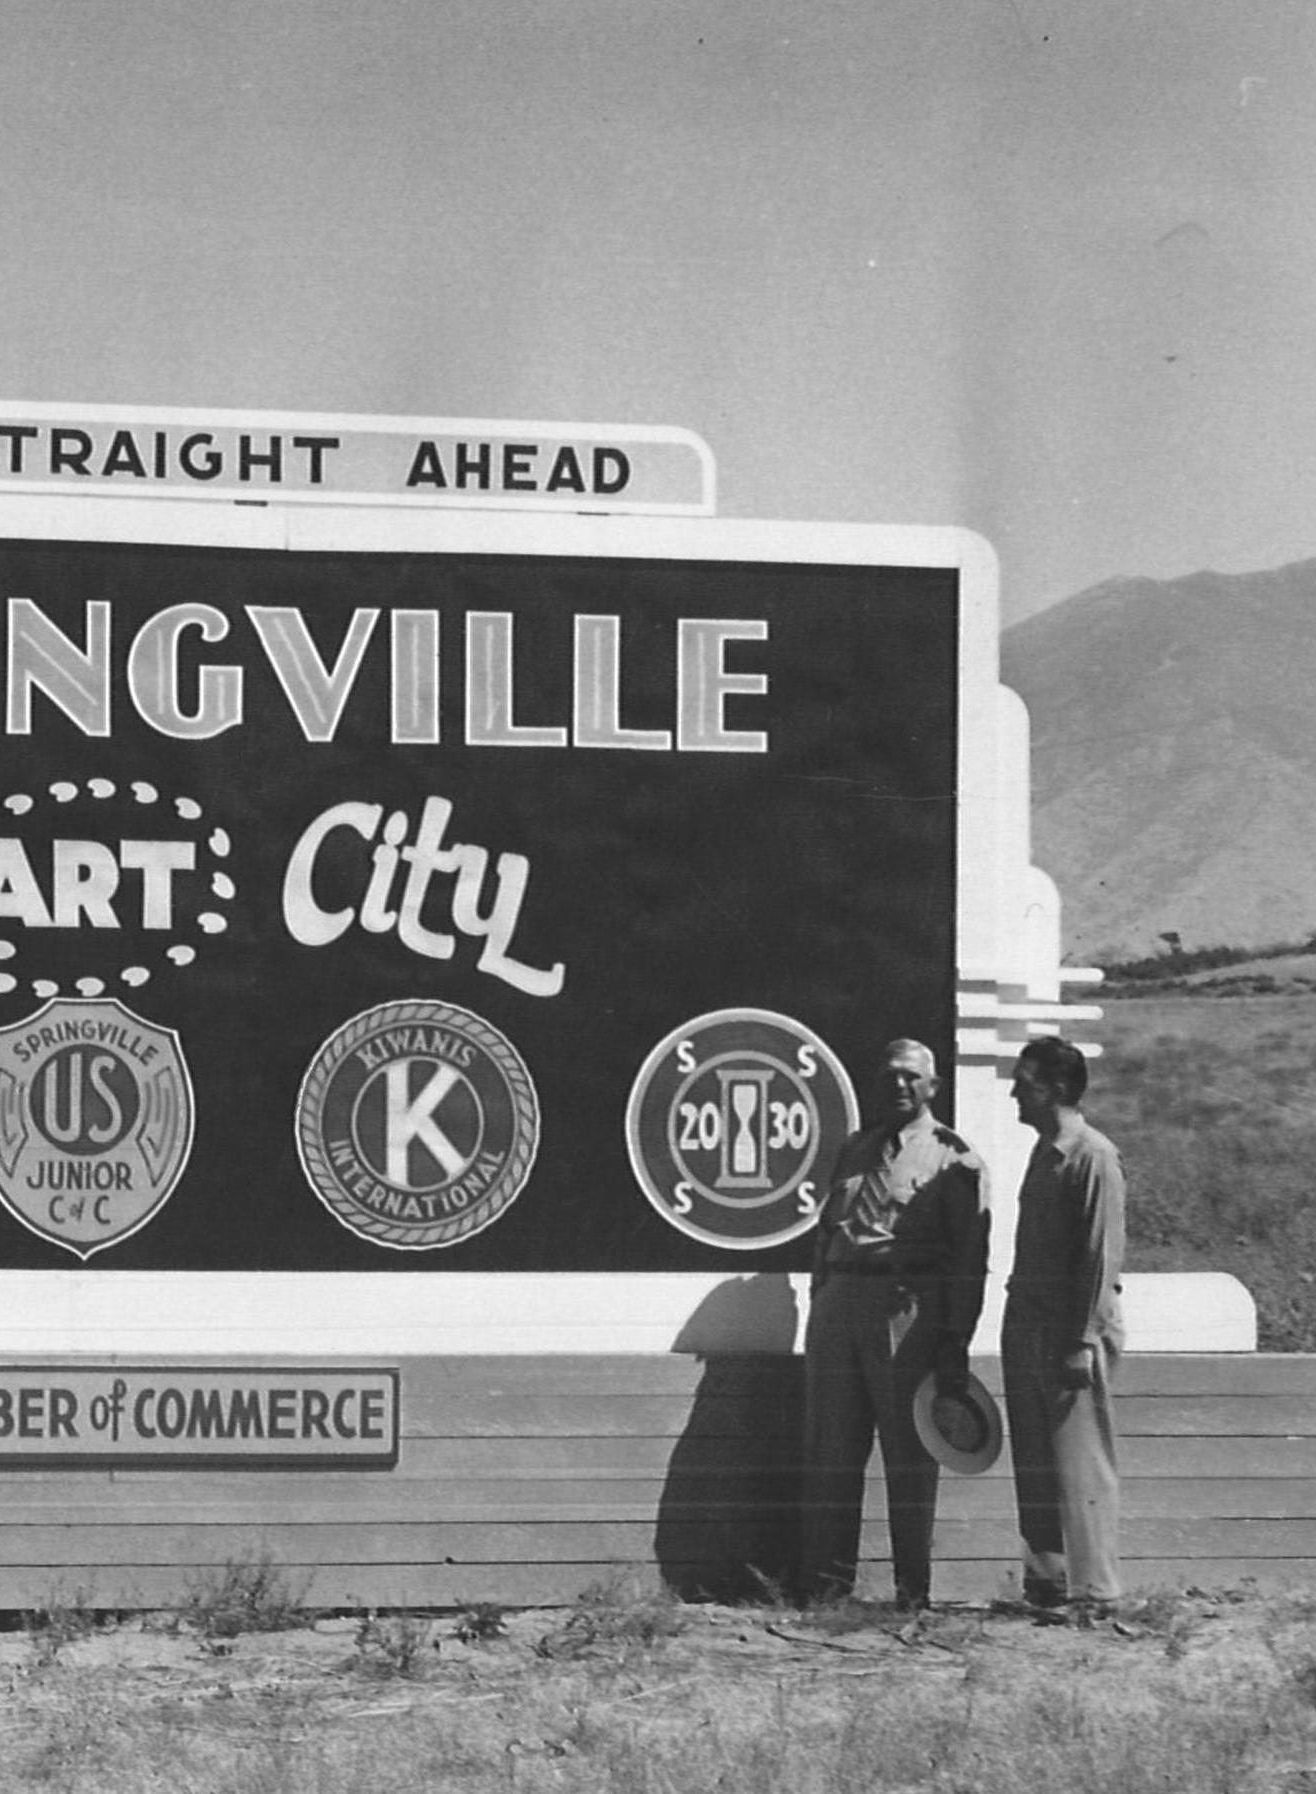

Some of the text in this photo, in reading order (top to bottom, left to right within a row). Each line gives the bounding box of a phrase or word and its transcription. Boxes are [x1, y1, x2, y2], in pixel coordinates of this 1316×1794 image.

[407, 441, 632, 494] AHEAD
[284, 796, 566, 997] City
[12, 1019, 160, 1067] SPRINGVILLE
[355, 1028, 477, 1071] KIWANIS
[677, 1040, 818, 1078] S S
[44, 1052, 122, 1143] US
[387, 1058, 469, 1188] K
[680, 1101, 809, 1150] 20 30
[26, 1160, 133, 1191] JUNIOR
[329, 1139, 505, 1218] INTERNATIONAL
[673, 1181, 816, 1214] S S
[48, 1195, 66, 1224] C
[93, 1195, 111, 1225] C
[89, 1378, 127, 1442] of
[132, 1387, 384, 1440] COMMERCE
